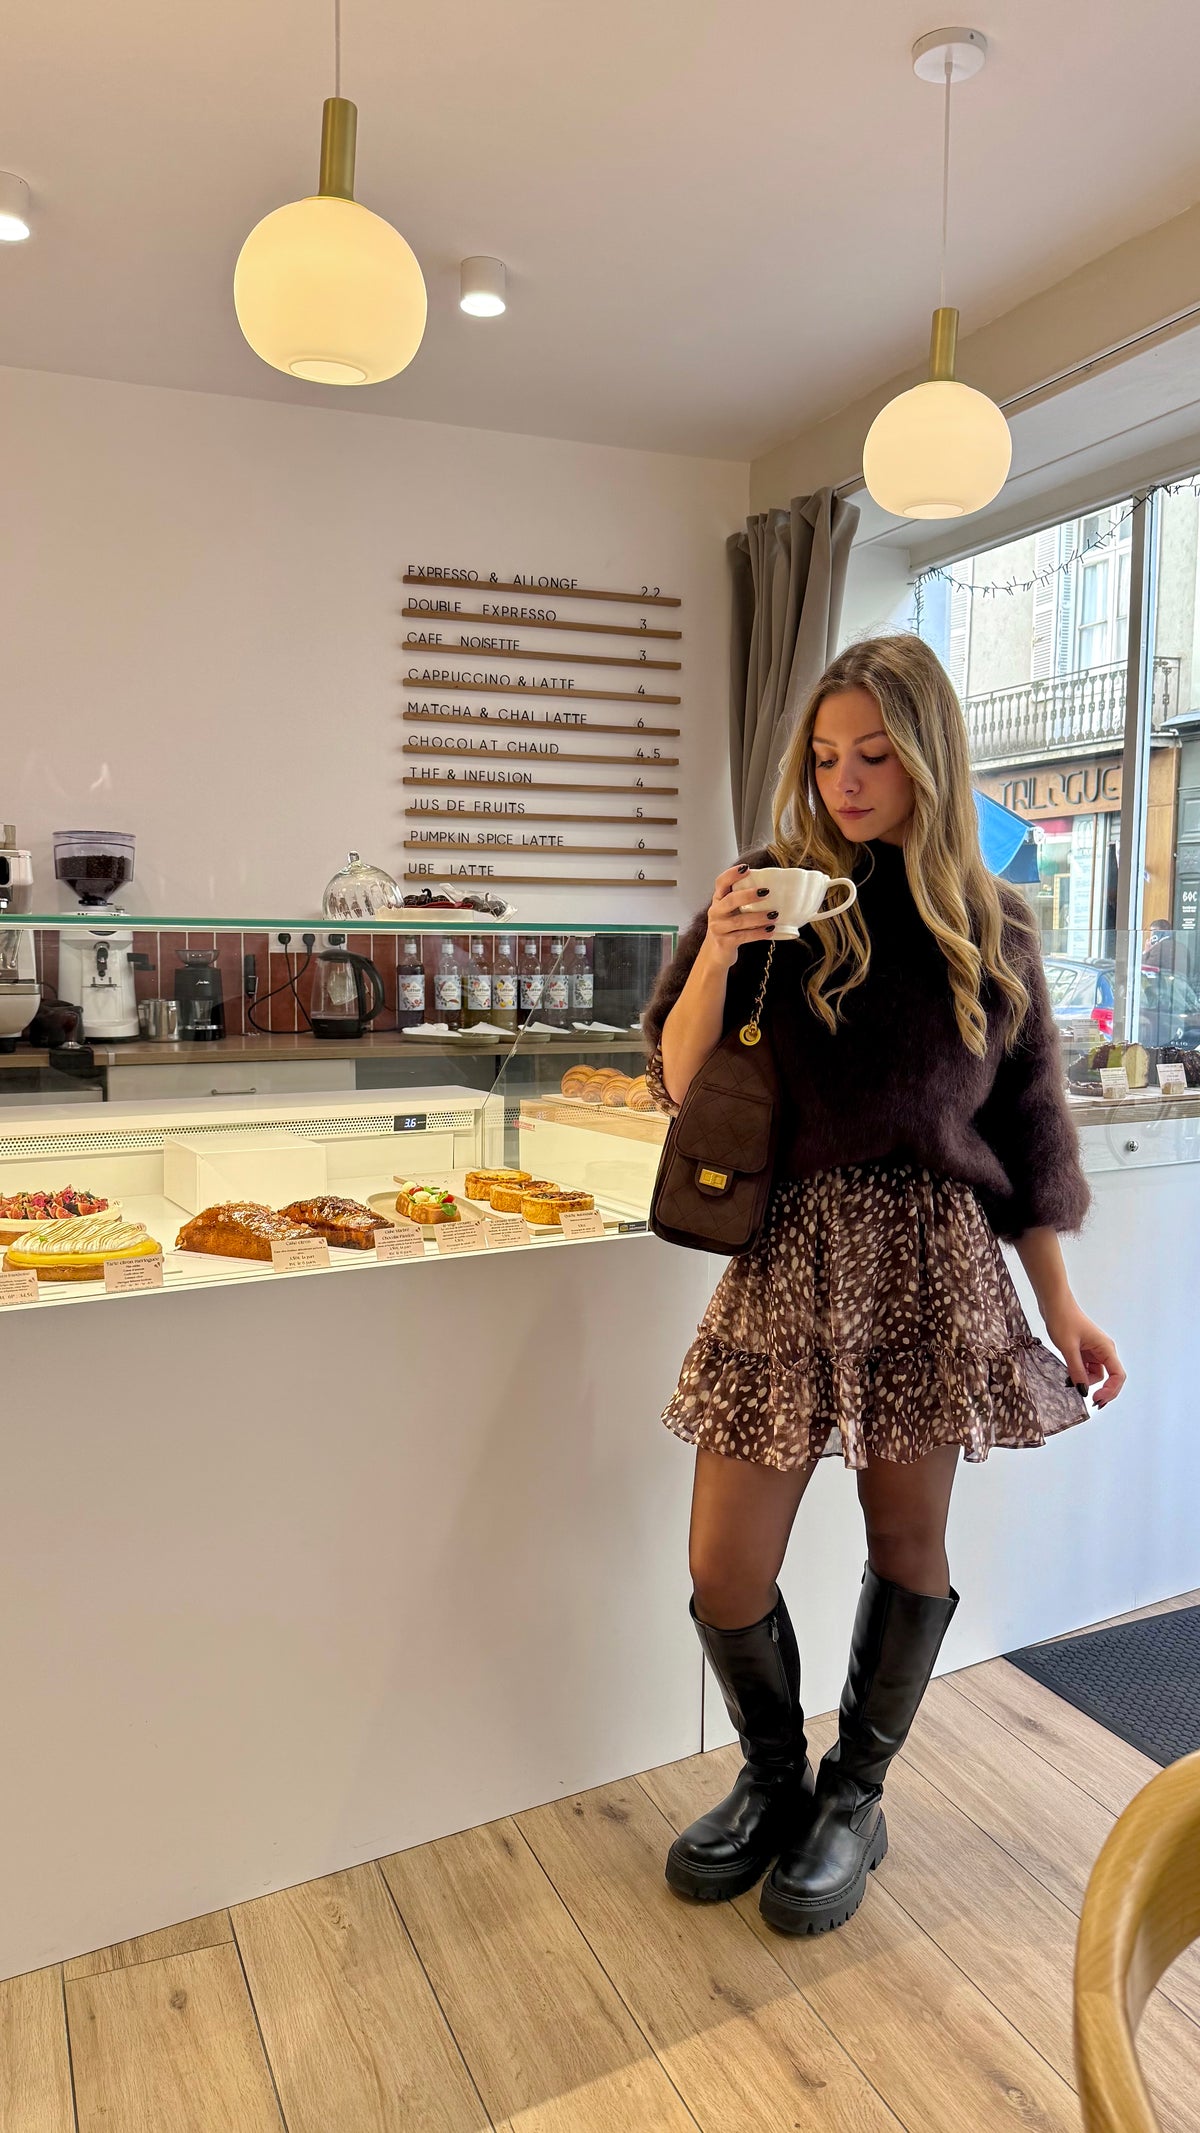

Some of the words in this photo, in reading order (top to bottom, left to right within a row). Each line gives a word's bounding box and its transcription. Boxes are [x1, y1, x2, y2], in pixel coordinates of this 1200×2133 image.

[408, 565, 478, 582] EXPRESSO
[489, 572, 498, 583] &
[408, 598, 461, 612] DOUBLE
[483, 604, 556, 621] EXPRESSO
[640, 619, 647, 630] 3
[407, 632, 442, 645] CAFE
[461, 636, 520, 650] NOISETTE
[640, 650, 647, 661] 3
[408, 668, 511, 686] CAPPUCCINO
[518, 676, 527, 686] &
[532, 677, 575, 690] LATTE
[637, 685, 645, 695] 4
[408, 702, 471, 718] MATCHA
[480, 707, 489, 719] &
[498, 708, 534, 721] CHAI
[545, 712, 587, 725] LATTE
[637, 718, 644, 728] 6
[408, 735, 498, 750] CHOCOLAT
[507, 741, 559, 754] CHAUD
[410, 767, 440, 779] THE
[447, 769, 456, 780] &
[464, 770, 532, 783] INFUSION
[636, 777, 643, 788] 4
[410, 799, 440, 810] JUS
[447, 800, 465, 811] DE
[474, 801, 525, 814] FRUITS
[636, 808, 643, 818] 5
[410, 830, 470, 844] PUMPKIN
[477, 833, 513, 845] SPICE
[522, 834, 564, 847] LATTE
[638, 839, 645, 849] 6
[408, 863, 434, 875] UBE
[450, 864, 494, 876] LATTE
[638, 870, 645, 880] 6
